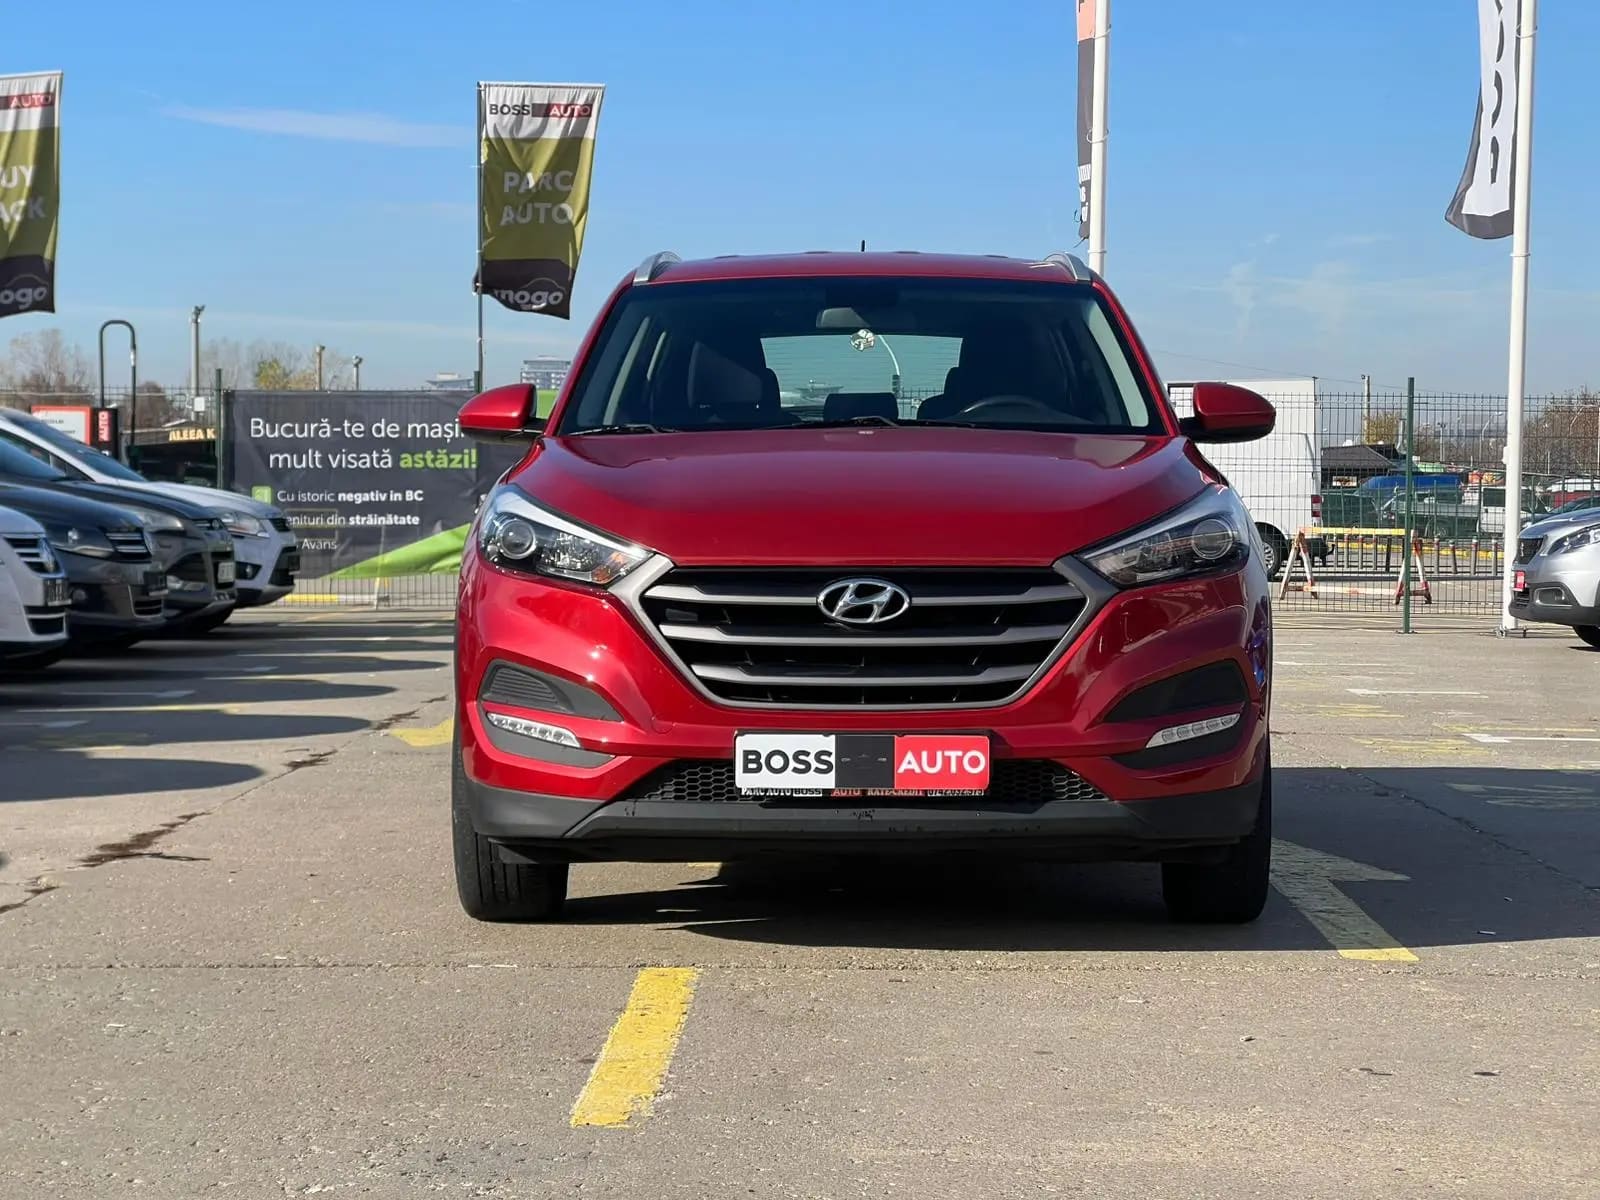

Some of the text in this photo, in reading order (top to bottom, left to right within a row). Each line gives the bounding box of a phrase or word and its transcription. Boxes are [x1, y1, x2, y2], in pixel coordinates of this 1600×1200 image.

[9, 94, 52, 109] AUTO
[489, 103, 591, 118] BOSS AUTO
[0, 165, 35, 189] UY
[503, 169, 573, 195] PARC
[499, 202, 573, 227] AUTO
[0, 287, 47, 310] ogo
[250, 418, 465, 443] Bucură-te de mași
[269, 448, 478, 469] mult visată astăzi!
[277, 490, 424, 506] Cu istoric negativ in BC
[286, 513, 420, 526] enituri din străinătate
[301, 538, 338, 550] Avans
[742, 749, 986, 775] BOSS AUTO
